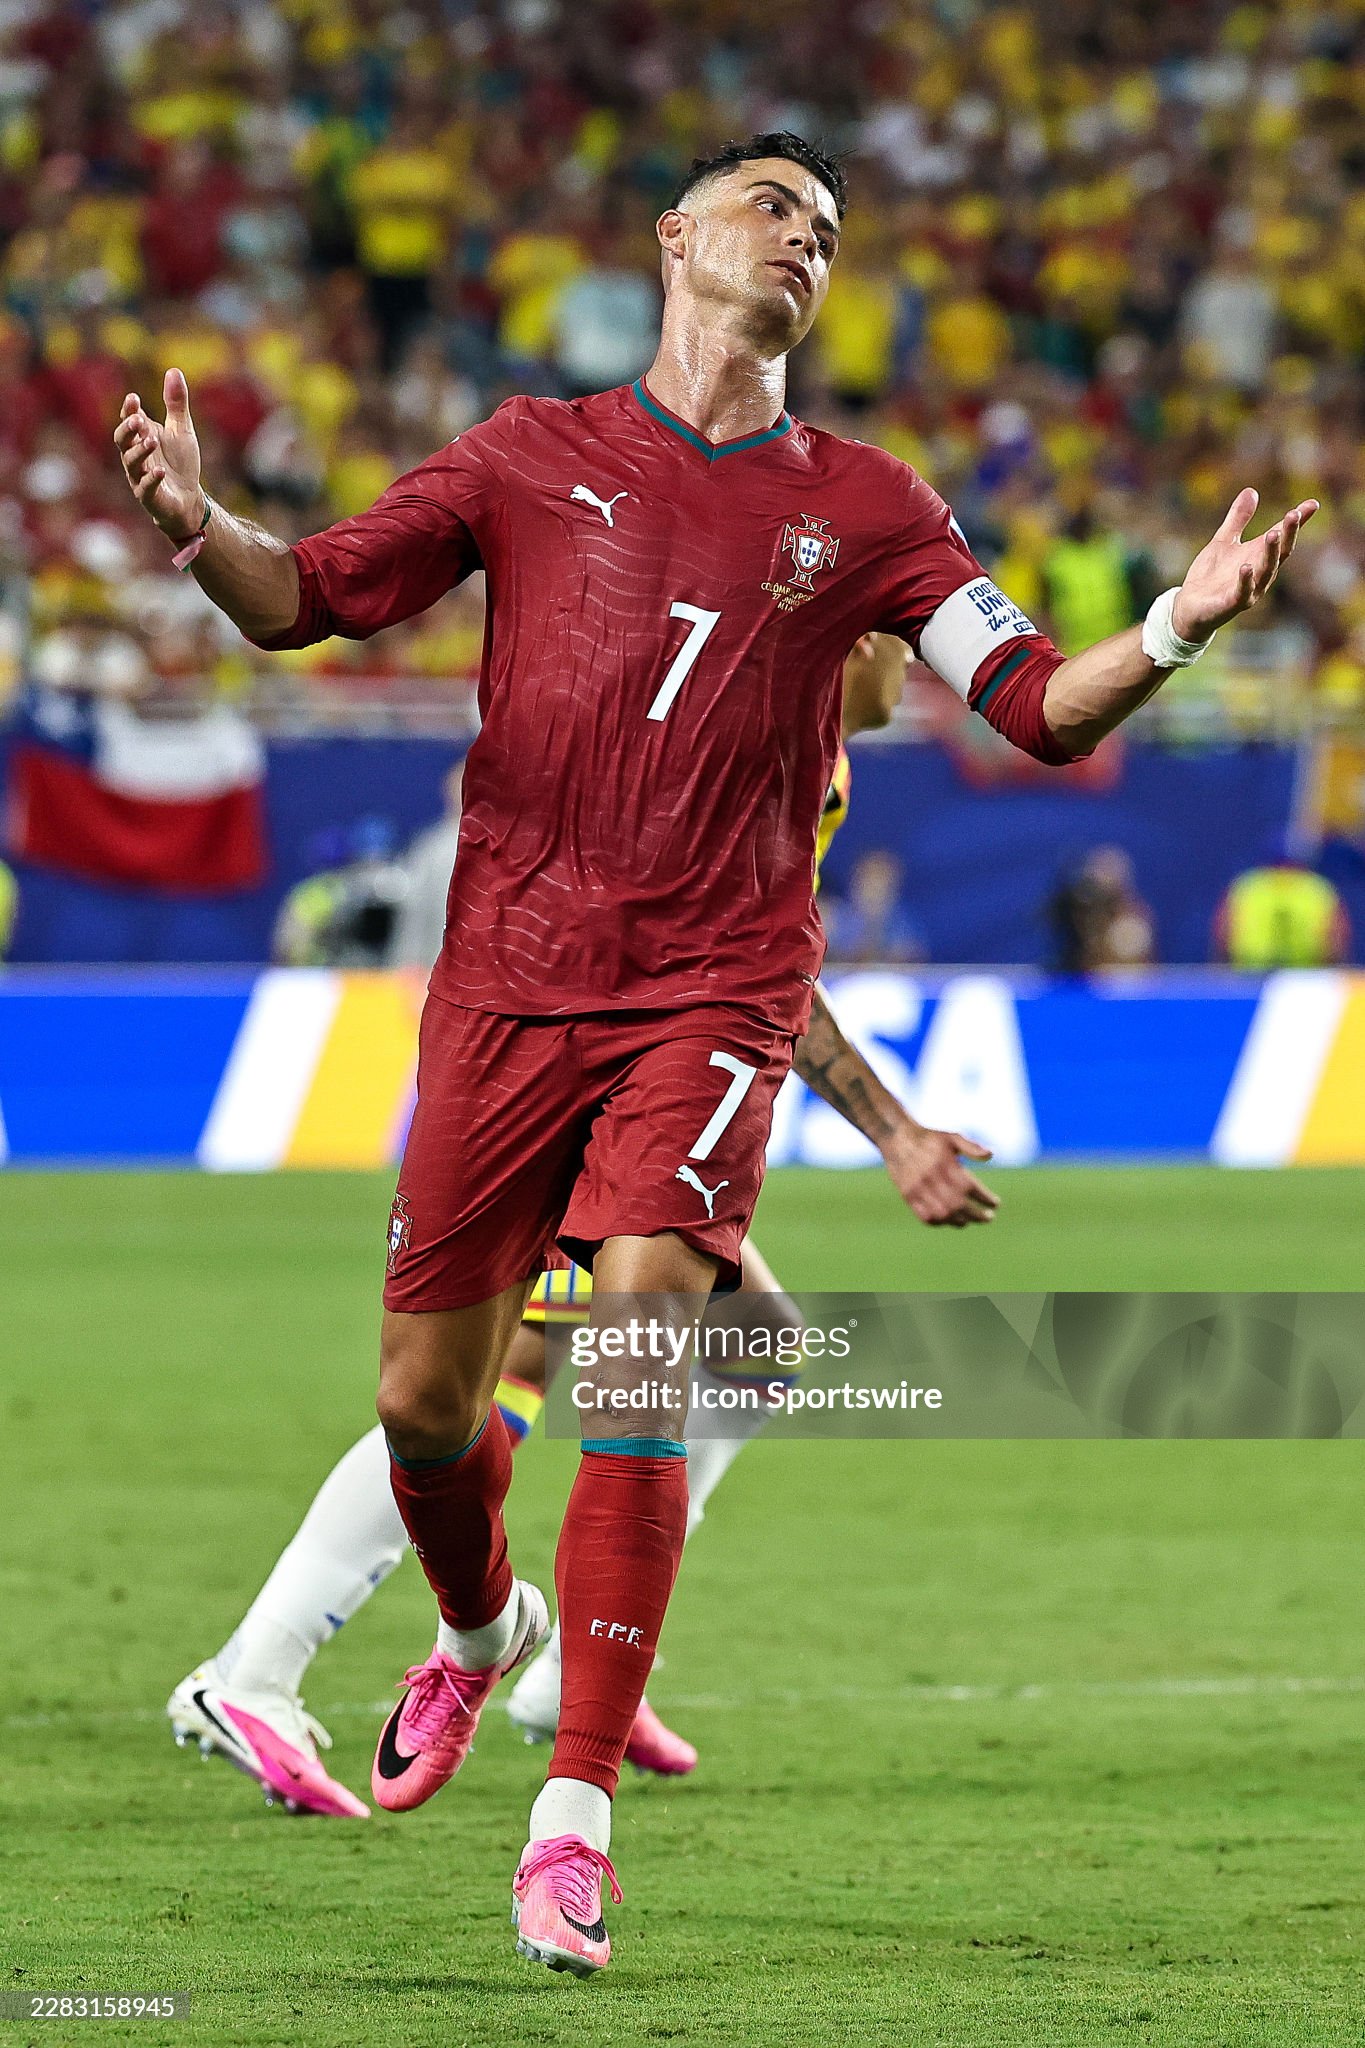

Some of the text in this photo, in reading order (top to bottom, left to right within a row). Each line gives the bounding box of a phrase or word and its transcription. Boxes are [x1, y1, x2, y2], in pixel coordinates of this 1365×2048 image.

[646, 601, 722, 722] 7
[985, 614, 1010, 632] the
[687, 1051, 758, 1161] 7
[765, 972, 1042, 1168] SA
